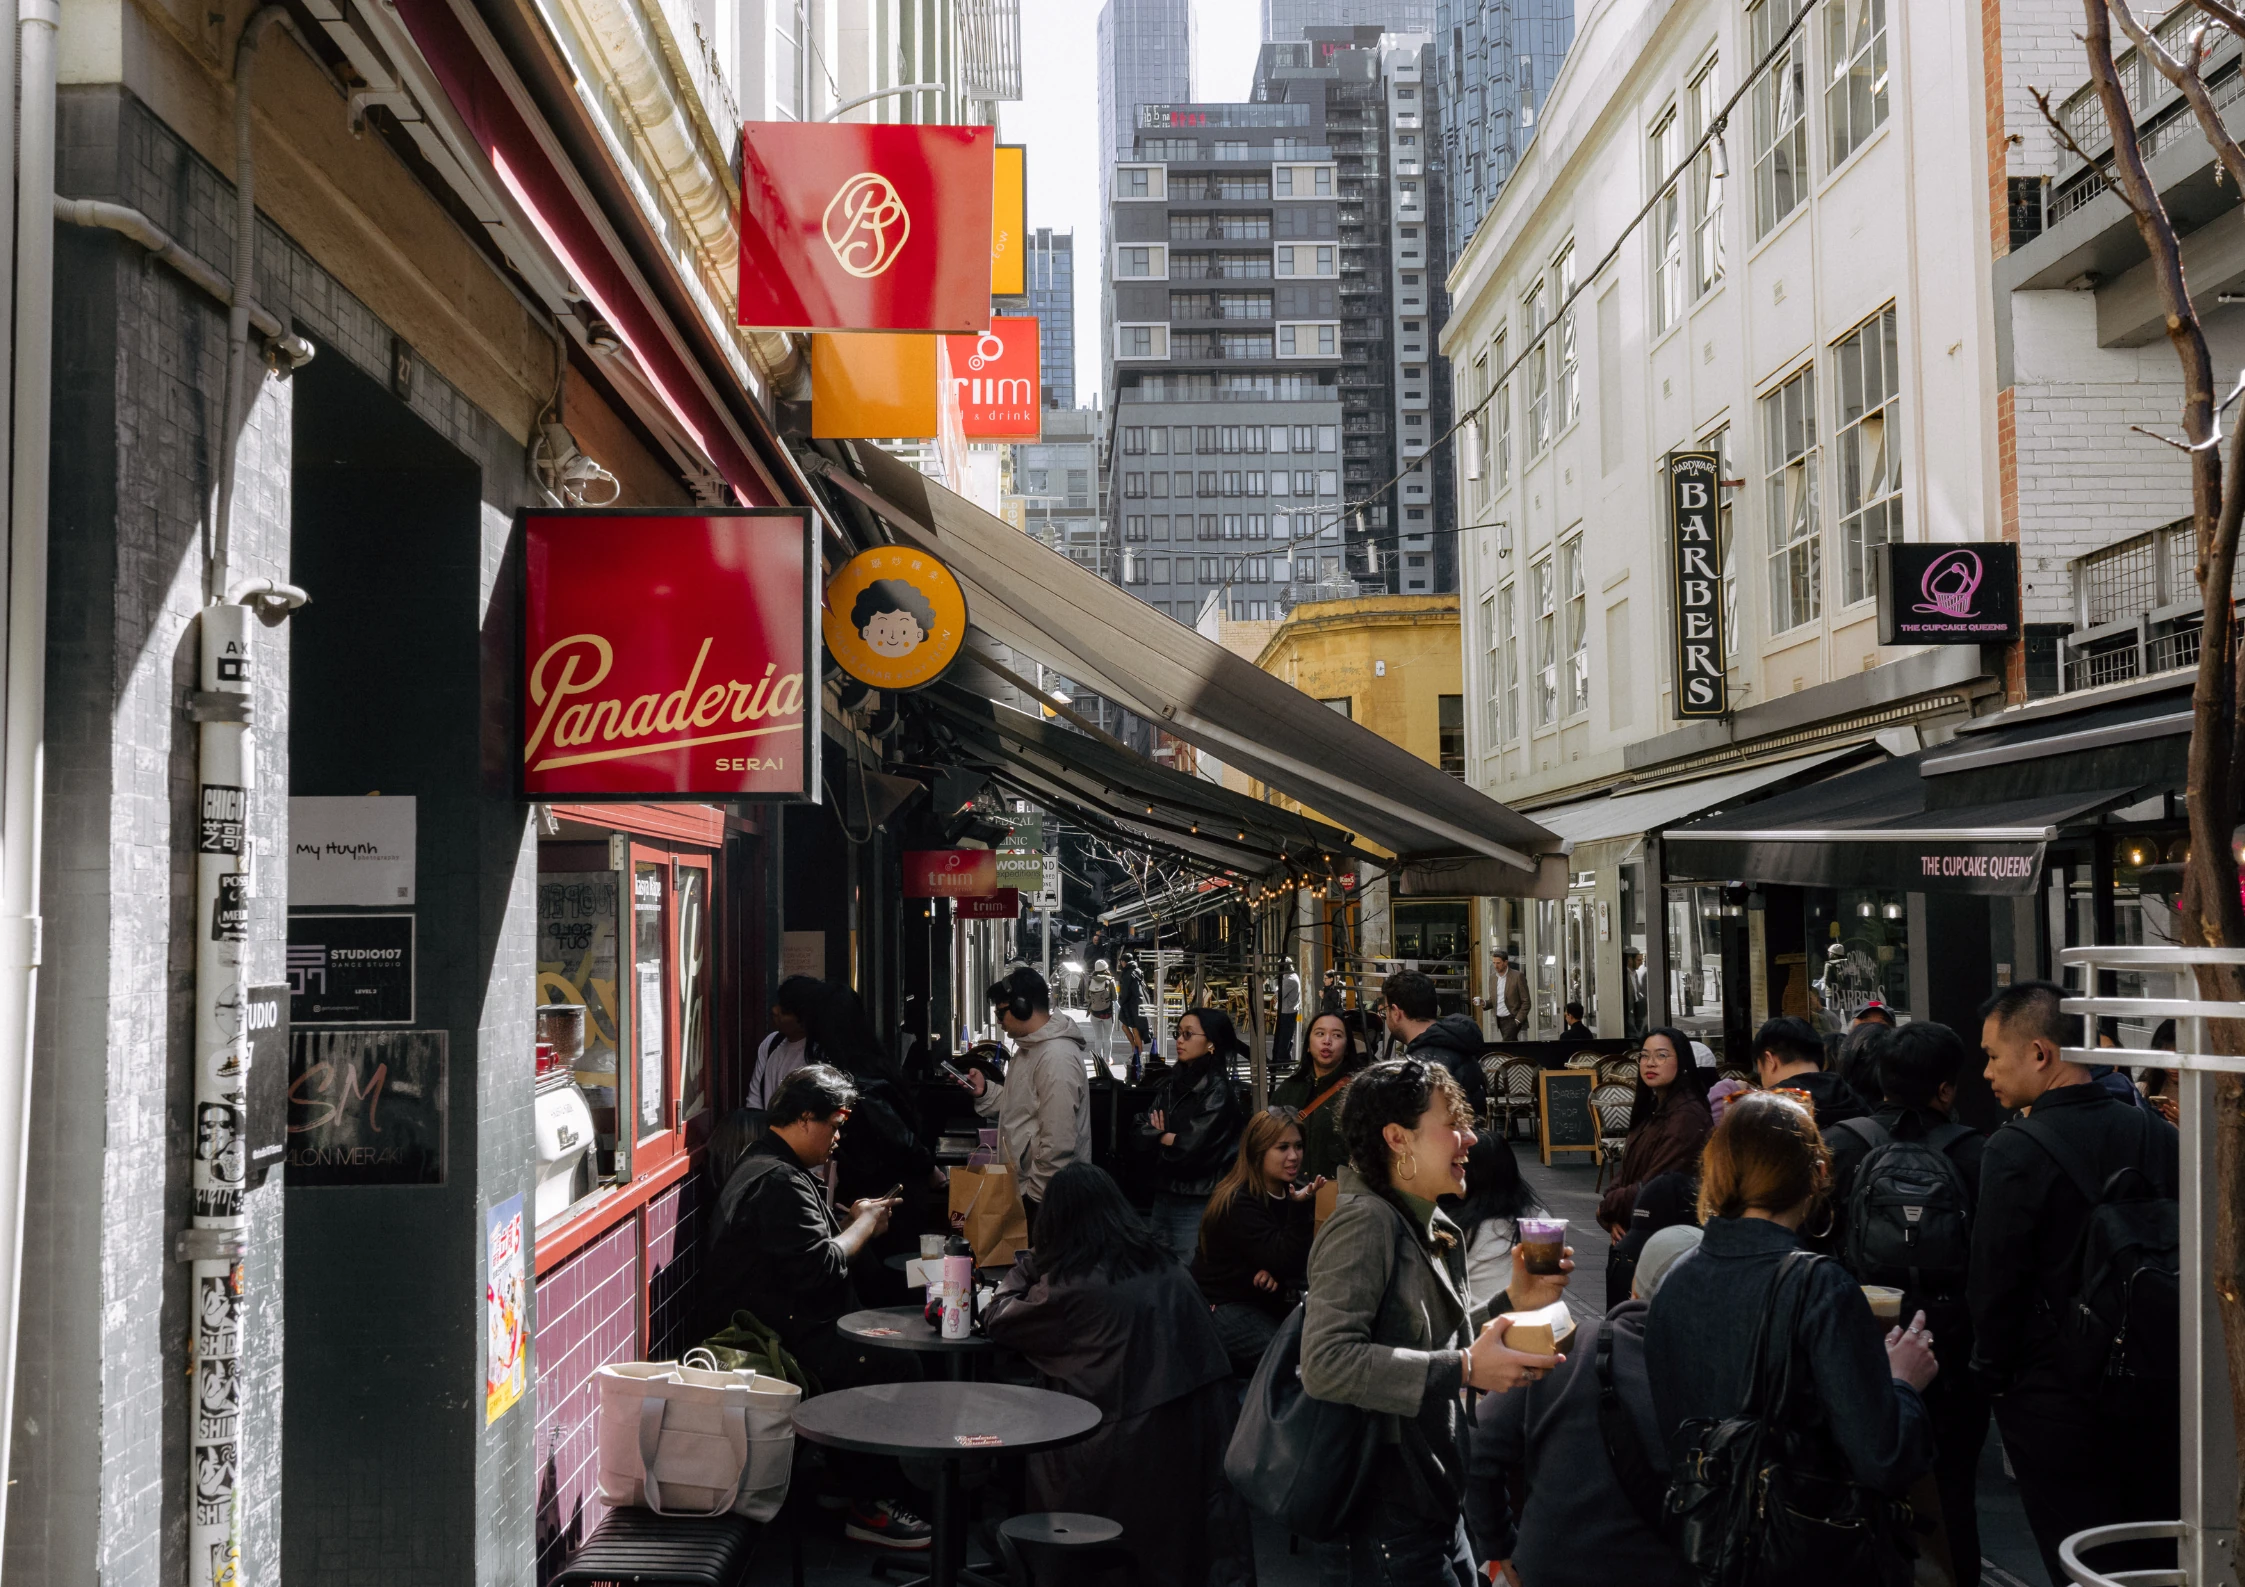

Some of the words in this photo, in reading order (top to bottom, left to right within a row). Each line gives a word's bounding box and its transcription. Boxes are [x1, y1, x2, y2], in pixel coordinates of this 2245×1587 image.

[953, 378, 1031, 405] riim
[989, 410, 1031, 421] drink
[1672, 460, 1717, 475] HARDWARE
[1689, 468, 1700, 477] LA
[1680, 482, 1725, 705] BARBERS
[1901, 624, 1920, 632] THE
[1921, 624, 1967, 632] CUPCAKE
[1968, 624, 2008, 632] QUEENS
[525, 634, 804, 763] Panaderia
[715, 758, 784, 771] SERAI
[203, 789, 245, 821] CHICO
[995, 816, 1034, 826] EDICAL
[202, 821, 242, 850] 芝哥
[1000, 836, 1028, 846] LINIC
[296, 844, 320, 860] My
[326, 842, 378, 860] Huynh
[996, 860, 1041, 871] WORLD
[1043, 861, 1055, 871] ND
[1921, 856, 1940, 876] THE
[1942, 856, 1988, 877] CUPCAKE
[1989, 856, 2033, 880] QUEENS
[996, 869, 1041, 880] expeditions
[331, 949, 402, 960] STUDIO107
[246, 1000, 278, 1031] TUDIO
[285, 1147, 332, 1166] ALON
